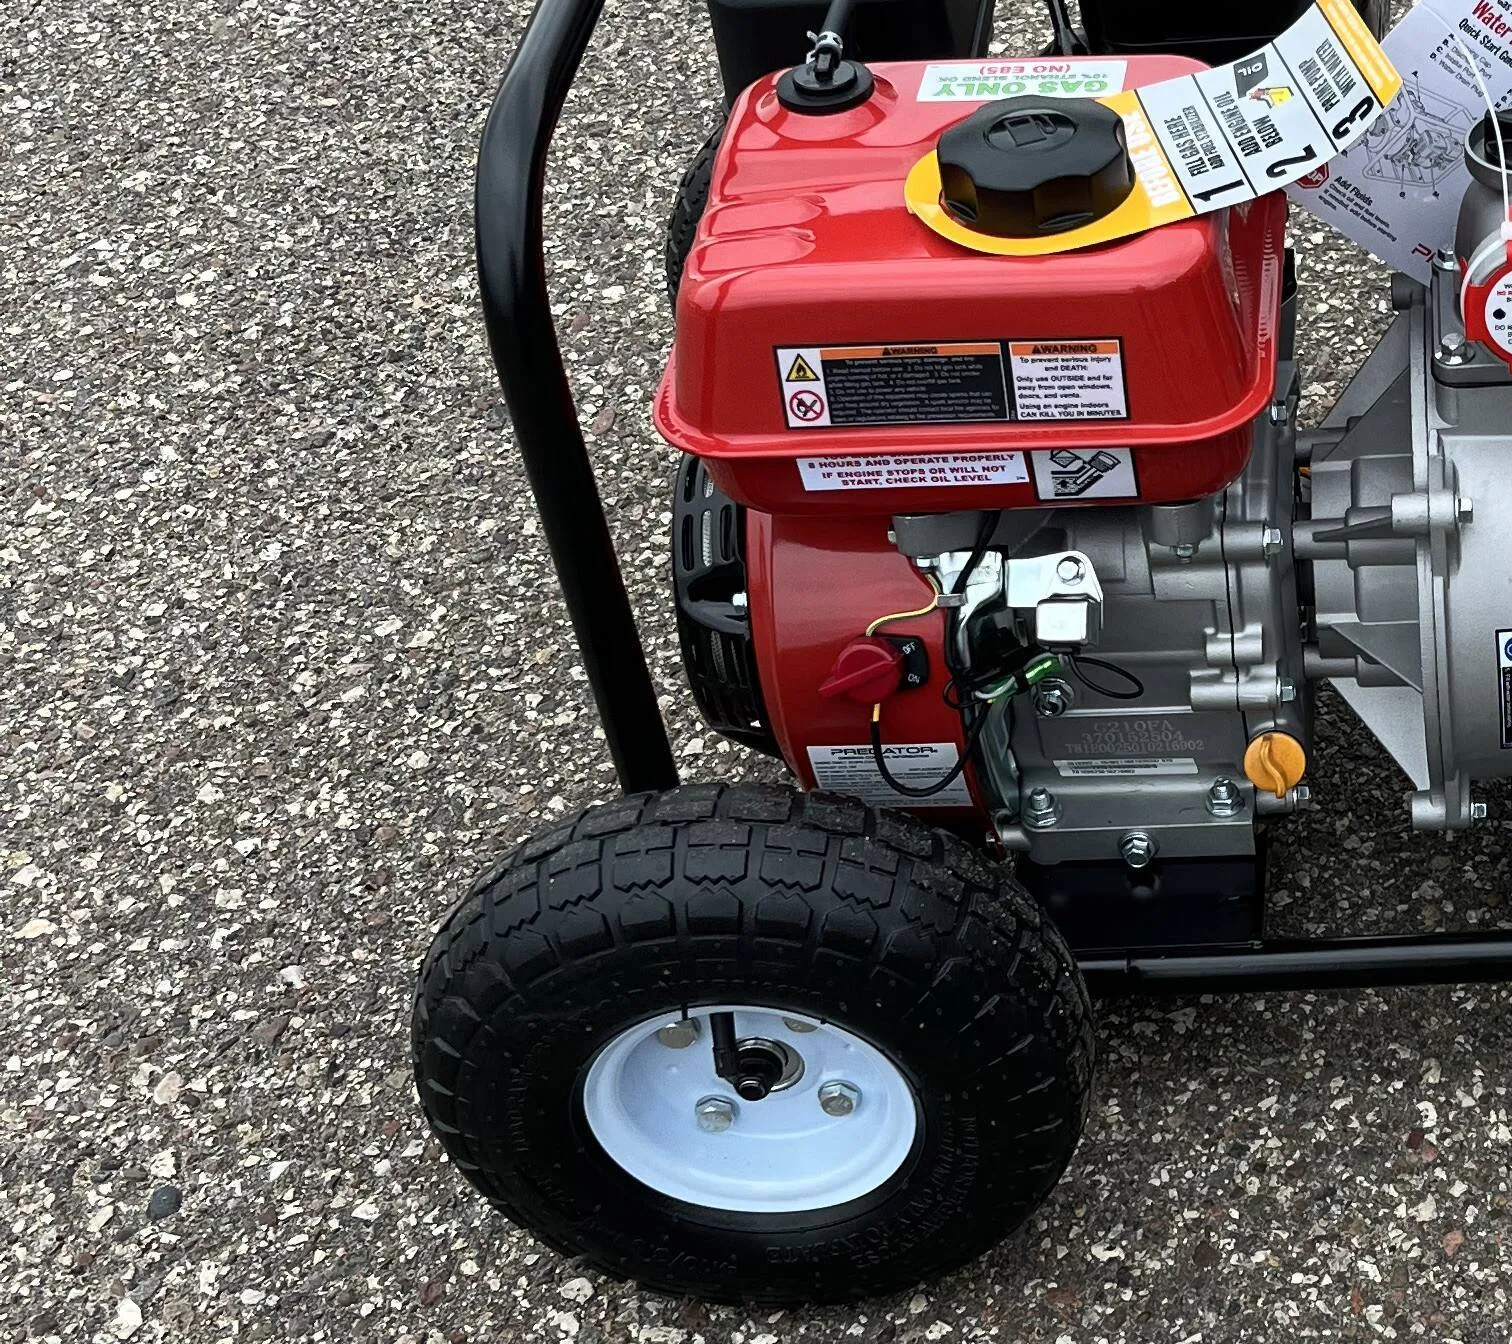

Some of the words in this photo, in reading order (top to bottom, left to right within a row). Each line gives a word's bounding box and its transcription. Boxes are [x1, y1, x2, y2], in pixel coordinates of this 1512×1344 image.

[1459, 18, 1481, 40] Quick
[1480, 35, 1501, 56] Start
[1316, 38, 1342, 76] WATER
[979, 64, 1025, 75] E85)
[1013, 74, 1077, 82] ETHANOL
[1032, 63, 1071, 73] (NO
[1238, 62, 1264, 77] OIL
[1299, 57, 1325, 86] PUMP
[932, 82, 1026, 96] ONLY
[1038, 80, 1109, 94] GAS
[1332, 65, 1357, 98] WITH
[1213, 91, 1235, 108] OIL
[1312, 78, 1340, 113] PRIME
[1221, 105, 1251, 138] ENGINE
[1331, 95, 1374, 139] 3
[1164, 115, 1191, 141] HERE
[1252, 115, 1283, 148] BELOW
[1176, 138, 1200, 159] GAS
[1238, 136, 1262, 156] ADD
[1185, 156, 1209, 177] FILL
[1265, 144, 1318, 178] 2
[1133, 150, 1181, 208] BEFORE
[1193, 178, 1245, 202] 1
[1334, 176, 1352, 190] Add
[1350, 187, 1373, 206] Fluids
[890, 347, 938, 355] WARNING
[1041, 344, 1097, 354] WARNING
[1091, 356, 1111, 364] injury
[819, 459, 862, 468] HOURS
[865, 458, 891, 466] AND
[894, 456, 949, 465] OPERATE
[953, 454, 1015, 463] PROPERLY
[822, 471, 833, 479] IF
[837, 470, 883, 478] ENGINE
[886, 468, 926, 477] STOPS
[929, 467, 947, 475] OR
[950, 466, 978, 474] WILL
[982, 464, 1006, 473] NOT
[885, 476, 927, 485] CHECK
[930, 475, 951, 483] OIL
[953, 474, 992, 482] LEVEL
[902, 641, 917, 655] OFF
[907, 673, 921, 684] ON
